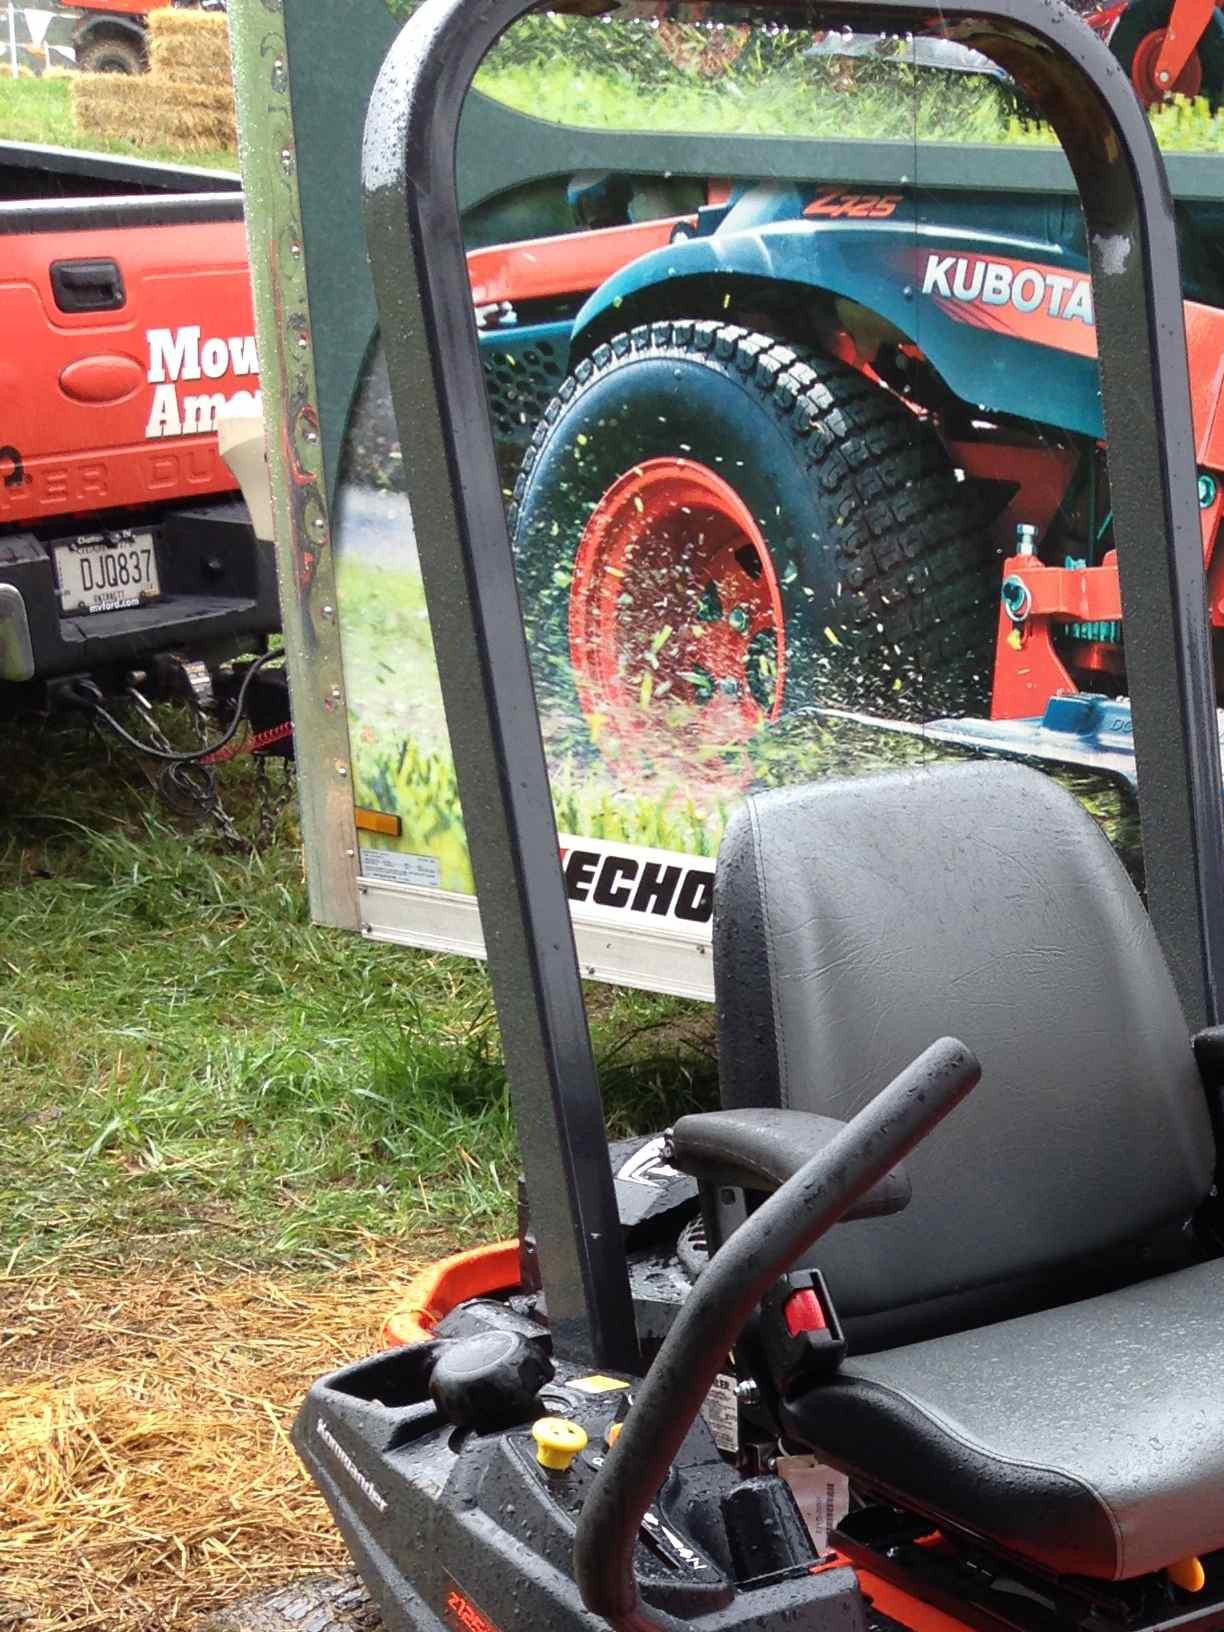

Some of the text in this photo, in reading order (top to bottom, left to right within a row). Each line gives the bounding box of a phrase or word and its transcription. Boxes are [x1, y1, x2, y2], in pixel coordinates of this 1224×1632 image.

[922, 255, 1095, 325] KUBOTA
[80, 549, 151, 591] DJQ837
[565, 850, 715, 924] ECHO
